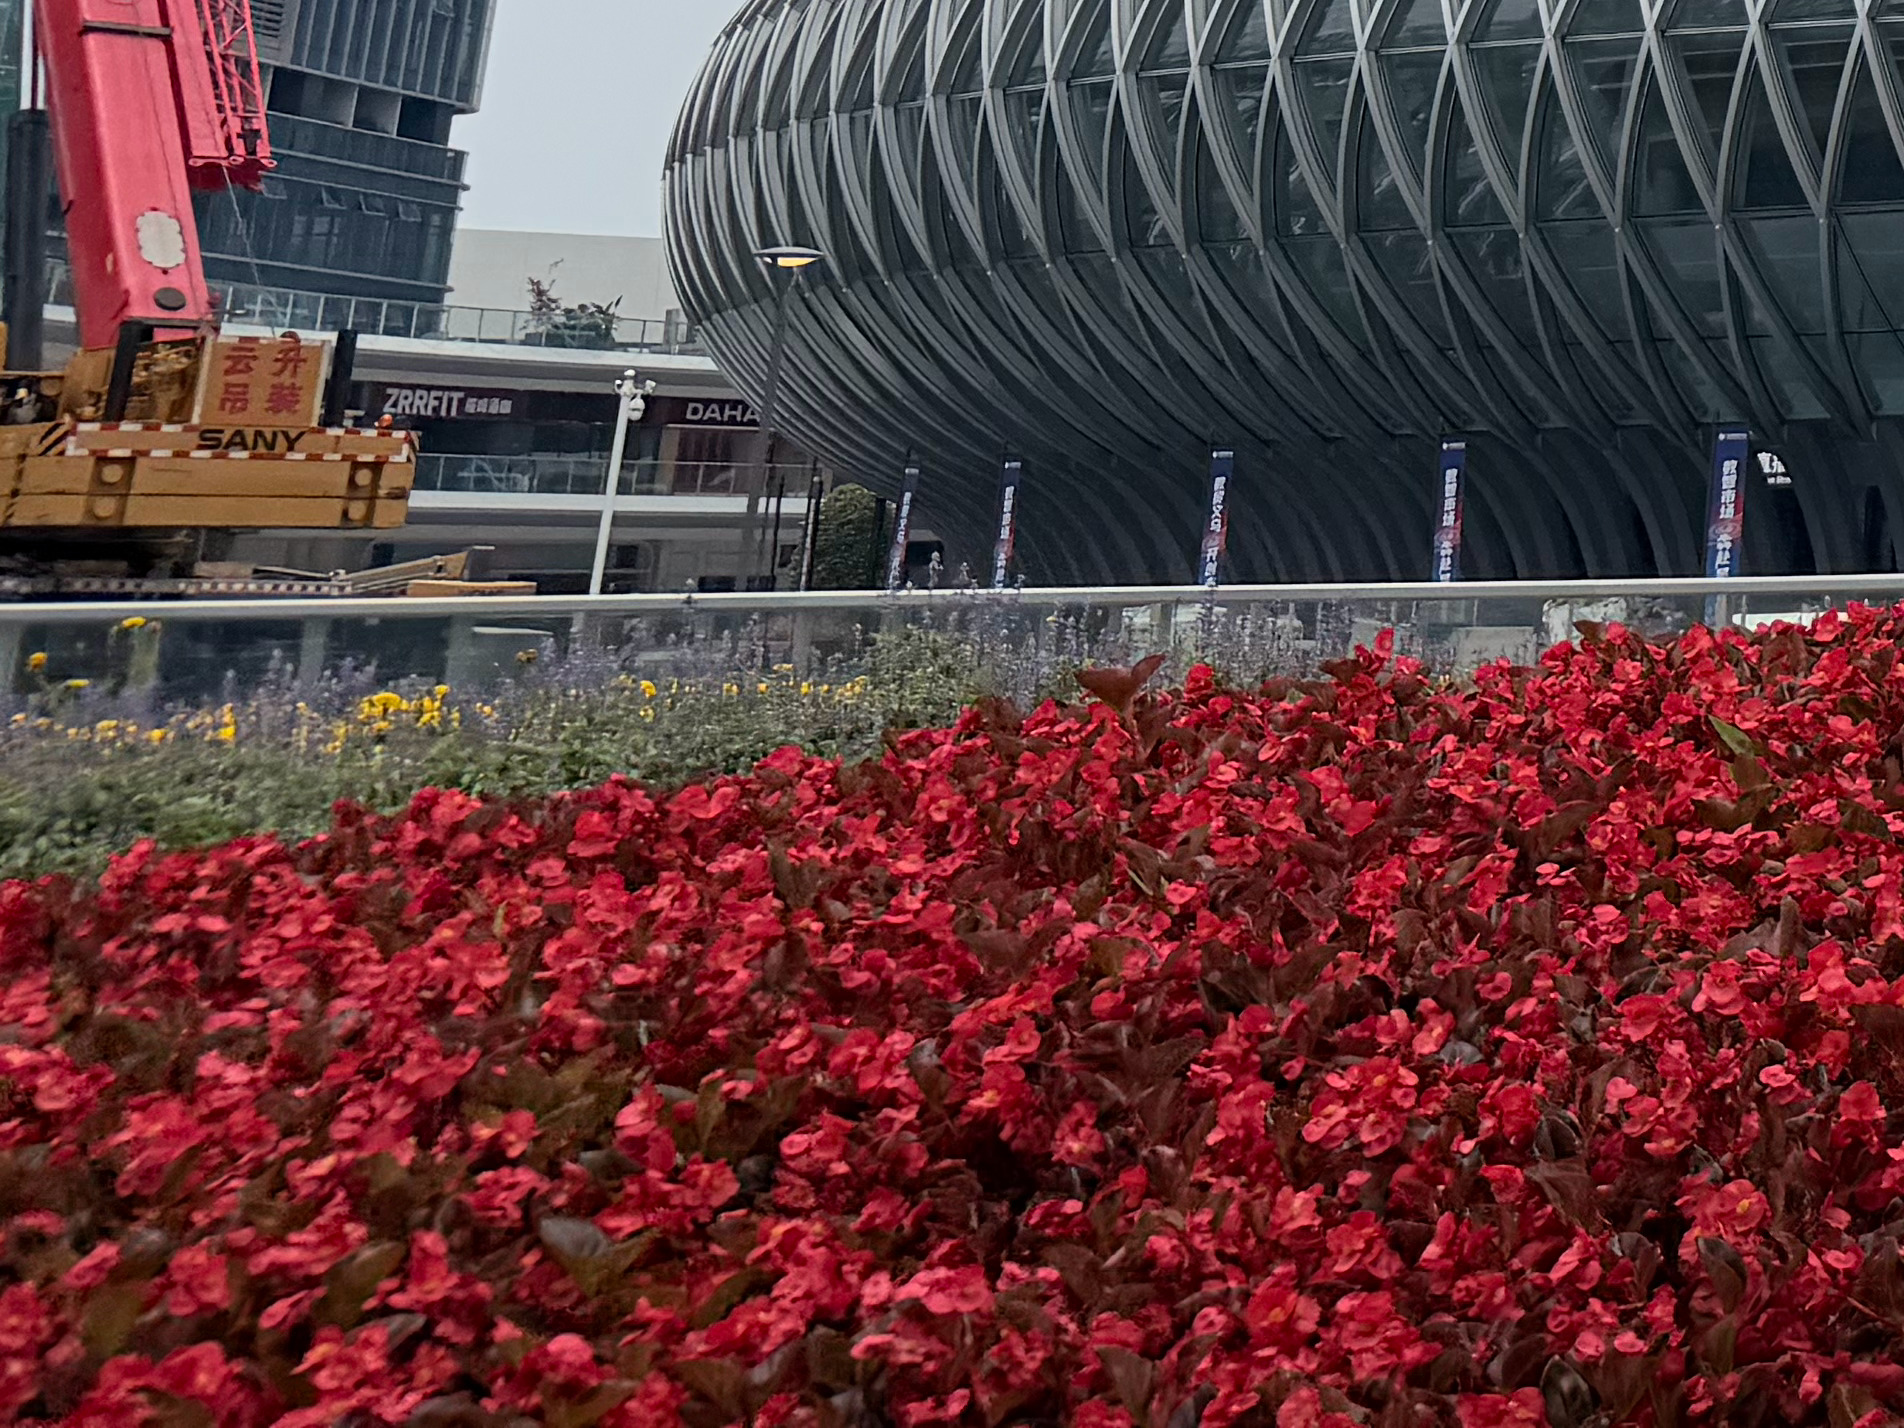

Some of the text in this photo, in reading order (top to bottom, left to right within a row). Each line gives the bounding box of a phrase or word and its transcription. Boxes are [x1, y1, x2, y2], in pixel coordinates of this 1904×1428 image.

[223, 345, 307, 379] 云升
[383, 387, 465, 417] ZRRFIT
[197, 428, 306, 452] SANY
